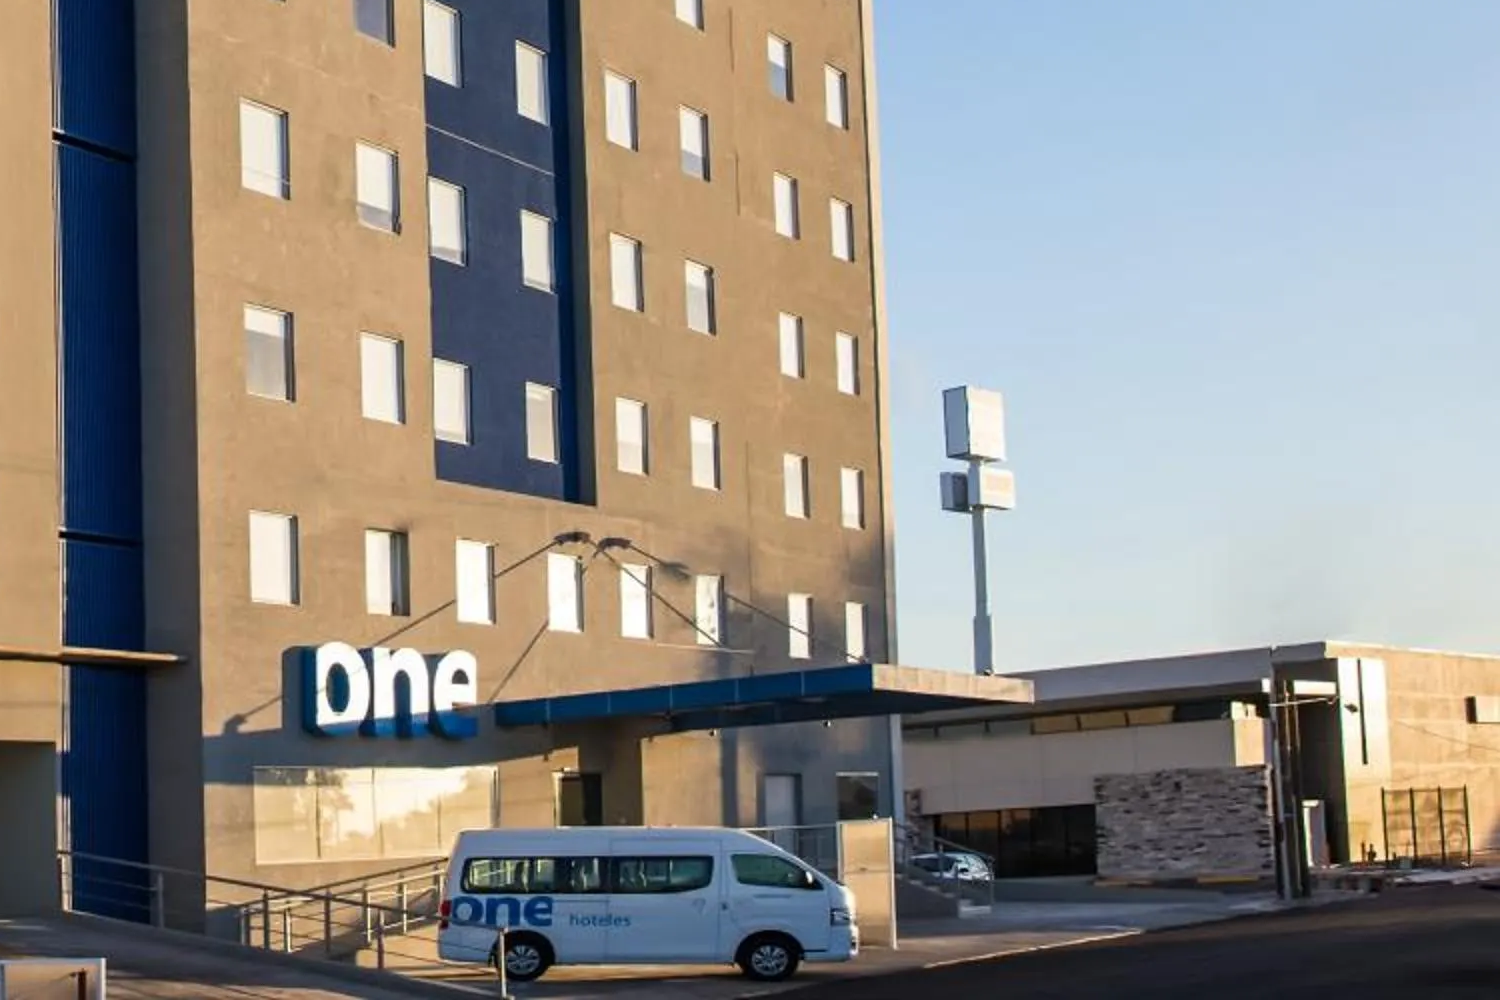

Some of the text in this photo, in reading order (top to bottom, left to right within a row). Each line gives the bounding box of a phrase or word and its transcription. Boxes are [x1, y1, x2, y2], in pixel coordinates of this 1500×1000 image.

[314, 641, 478, 739] one
[452, 896, 632, 928] one hoteles
